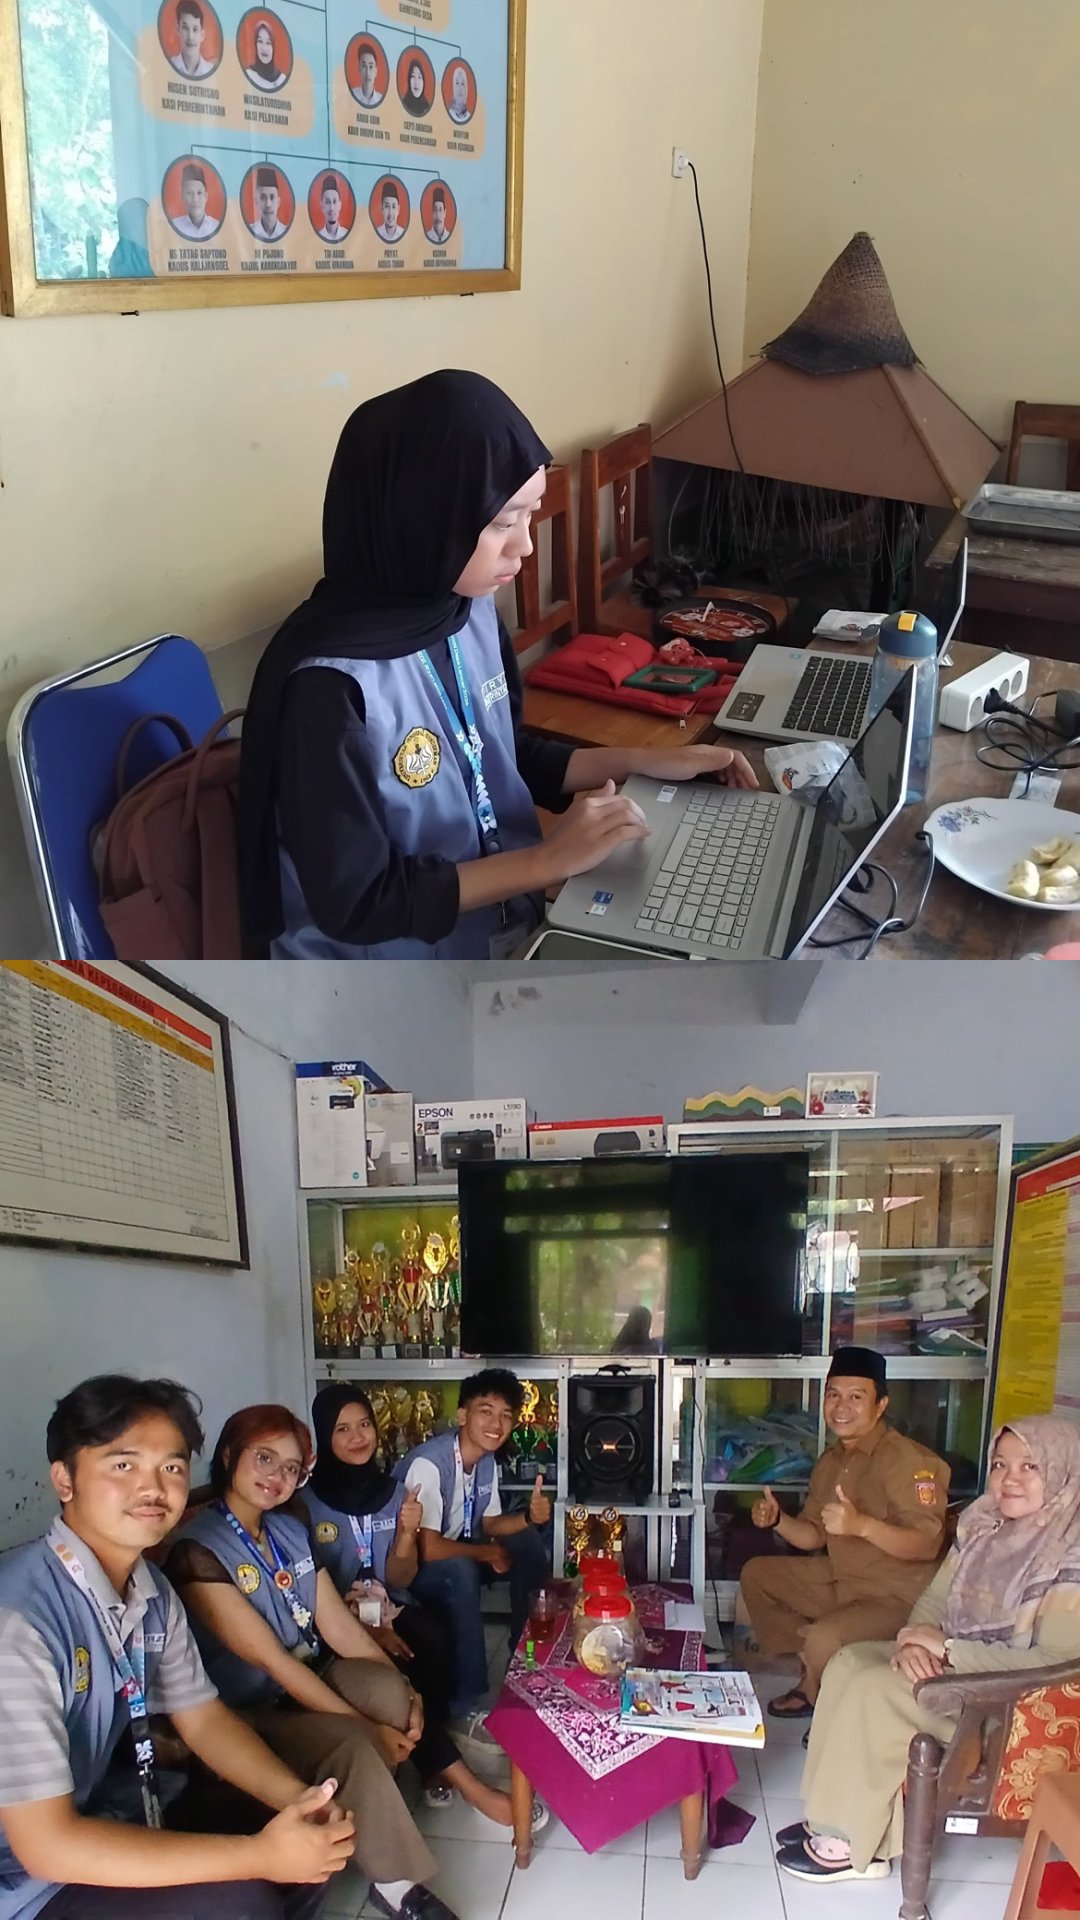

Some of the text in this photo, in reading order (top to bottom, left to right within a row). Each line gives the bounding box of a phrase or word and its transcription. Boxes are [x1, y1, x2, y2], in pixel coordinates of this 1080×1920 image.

[161, 98, 225, 117] KASI PEMERINTAHAN
[244, 110, 258, 121] KASI
[168, 260, 189, 272] KADUS
[418, 1107, 453, 1118] EPSON
